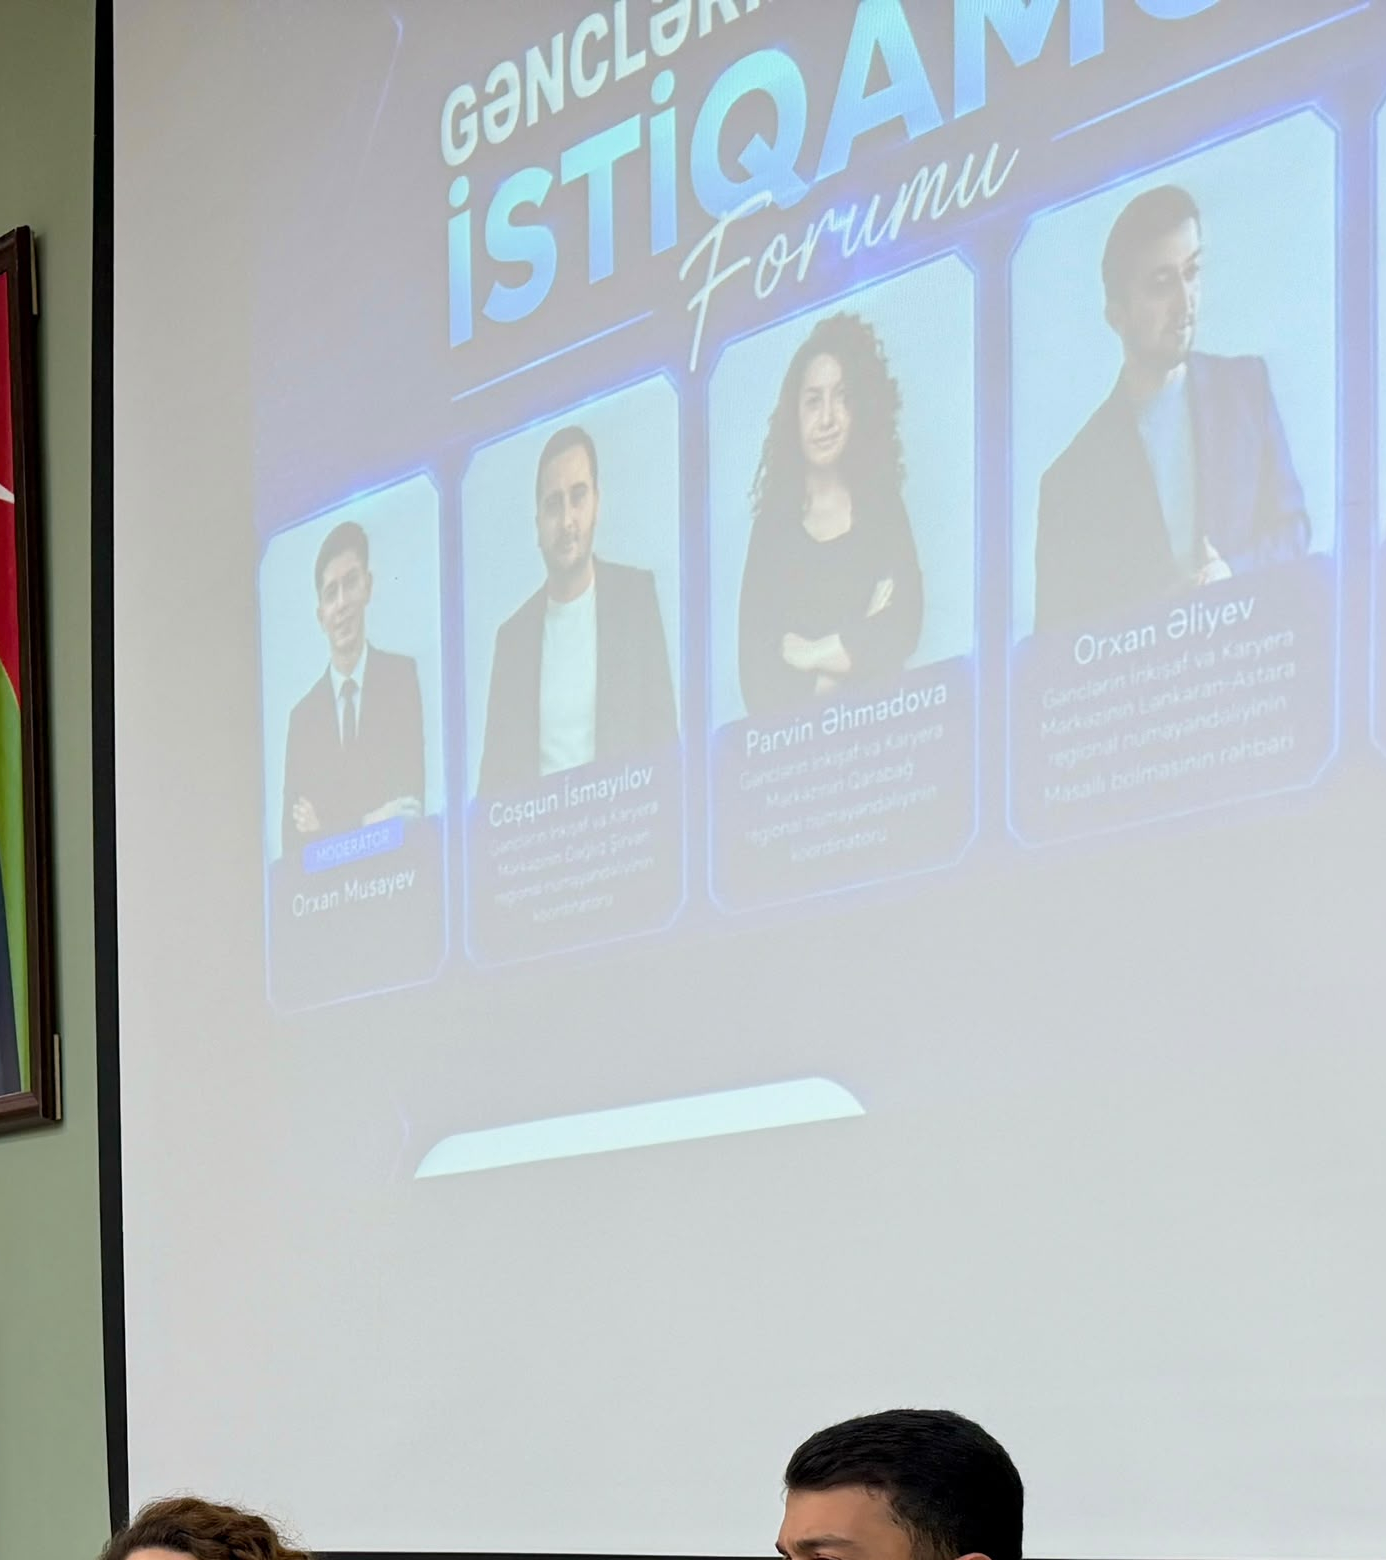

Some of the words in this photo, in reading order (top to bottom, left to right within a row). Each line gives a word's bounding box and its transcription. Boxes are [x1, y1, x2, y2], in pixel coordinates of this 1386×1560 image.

[679, 143, 1018, 371] Forumu
[1074, 622, 1157, 665] Orxan
[1166, 596, 1256, 640] Əliyev
[489, 795, 558, 829] Coşqun
[316, 829, 390, 863] MODERATOR
[292, 890, 339, 917] Orxan
[344, 869, 416, 904] Musayev
